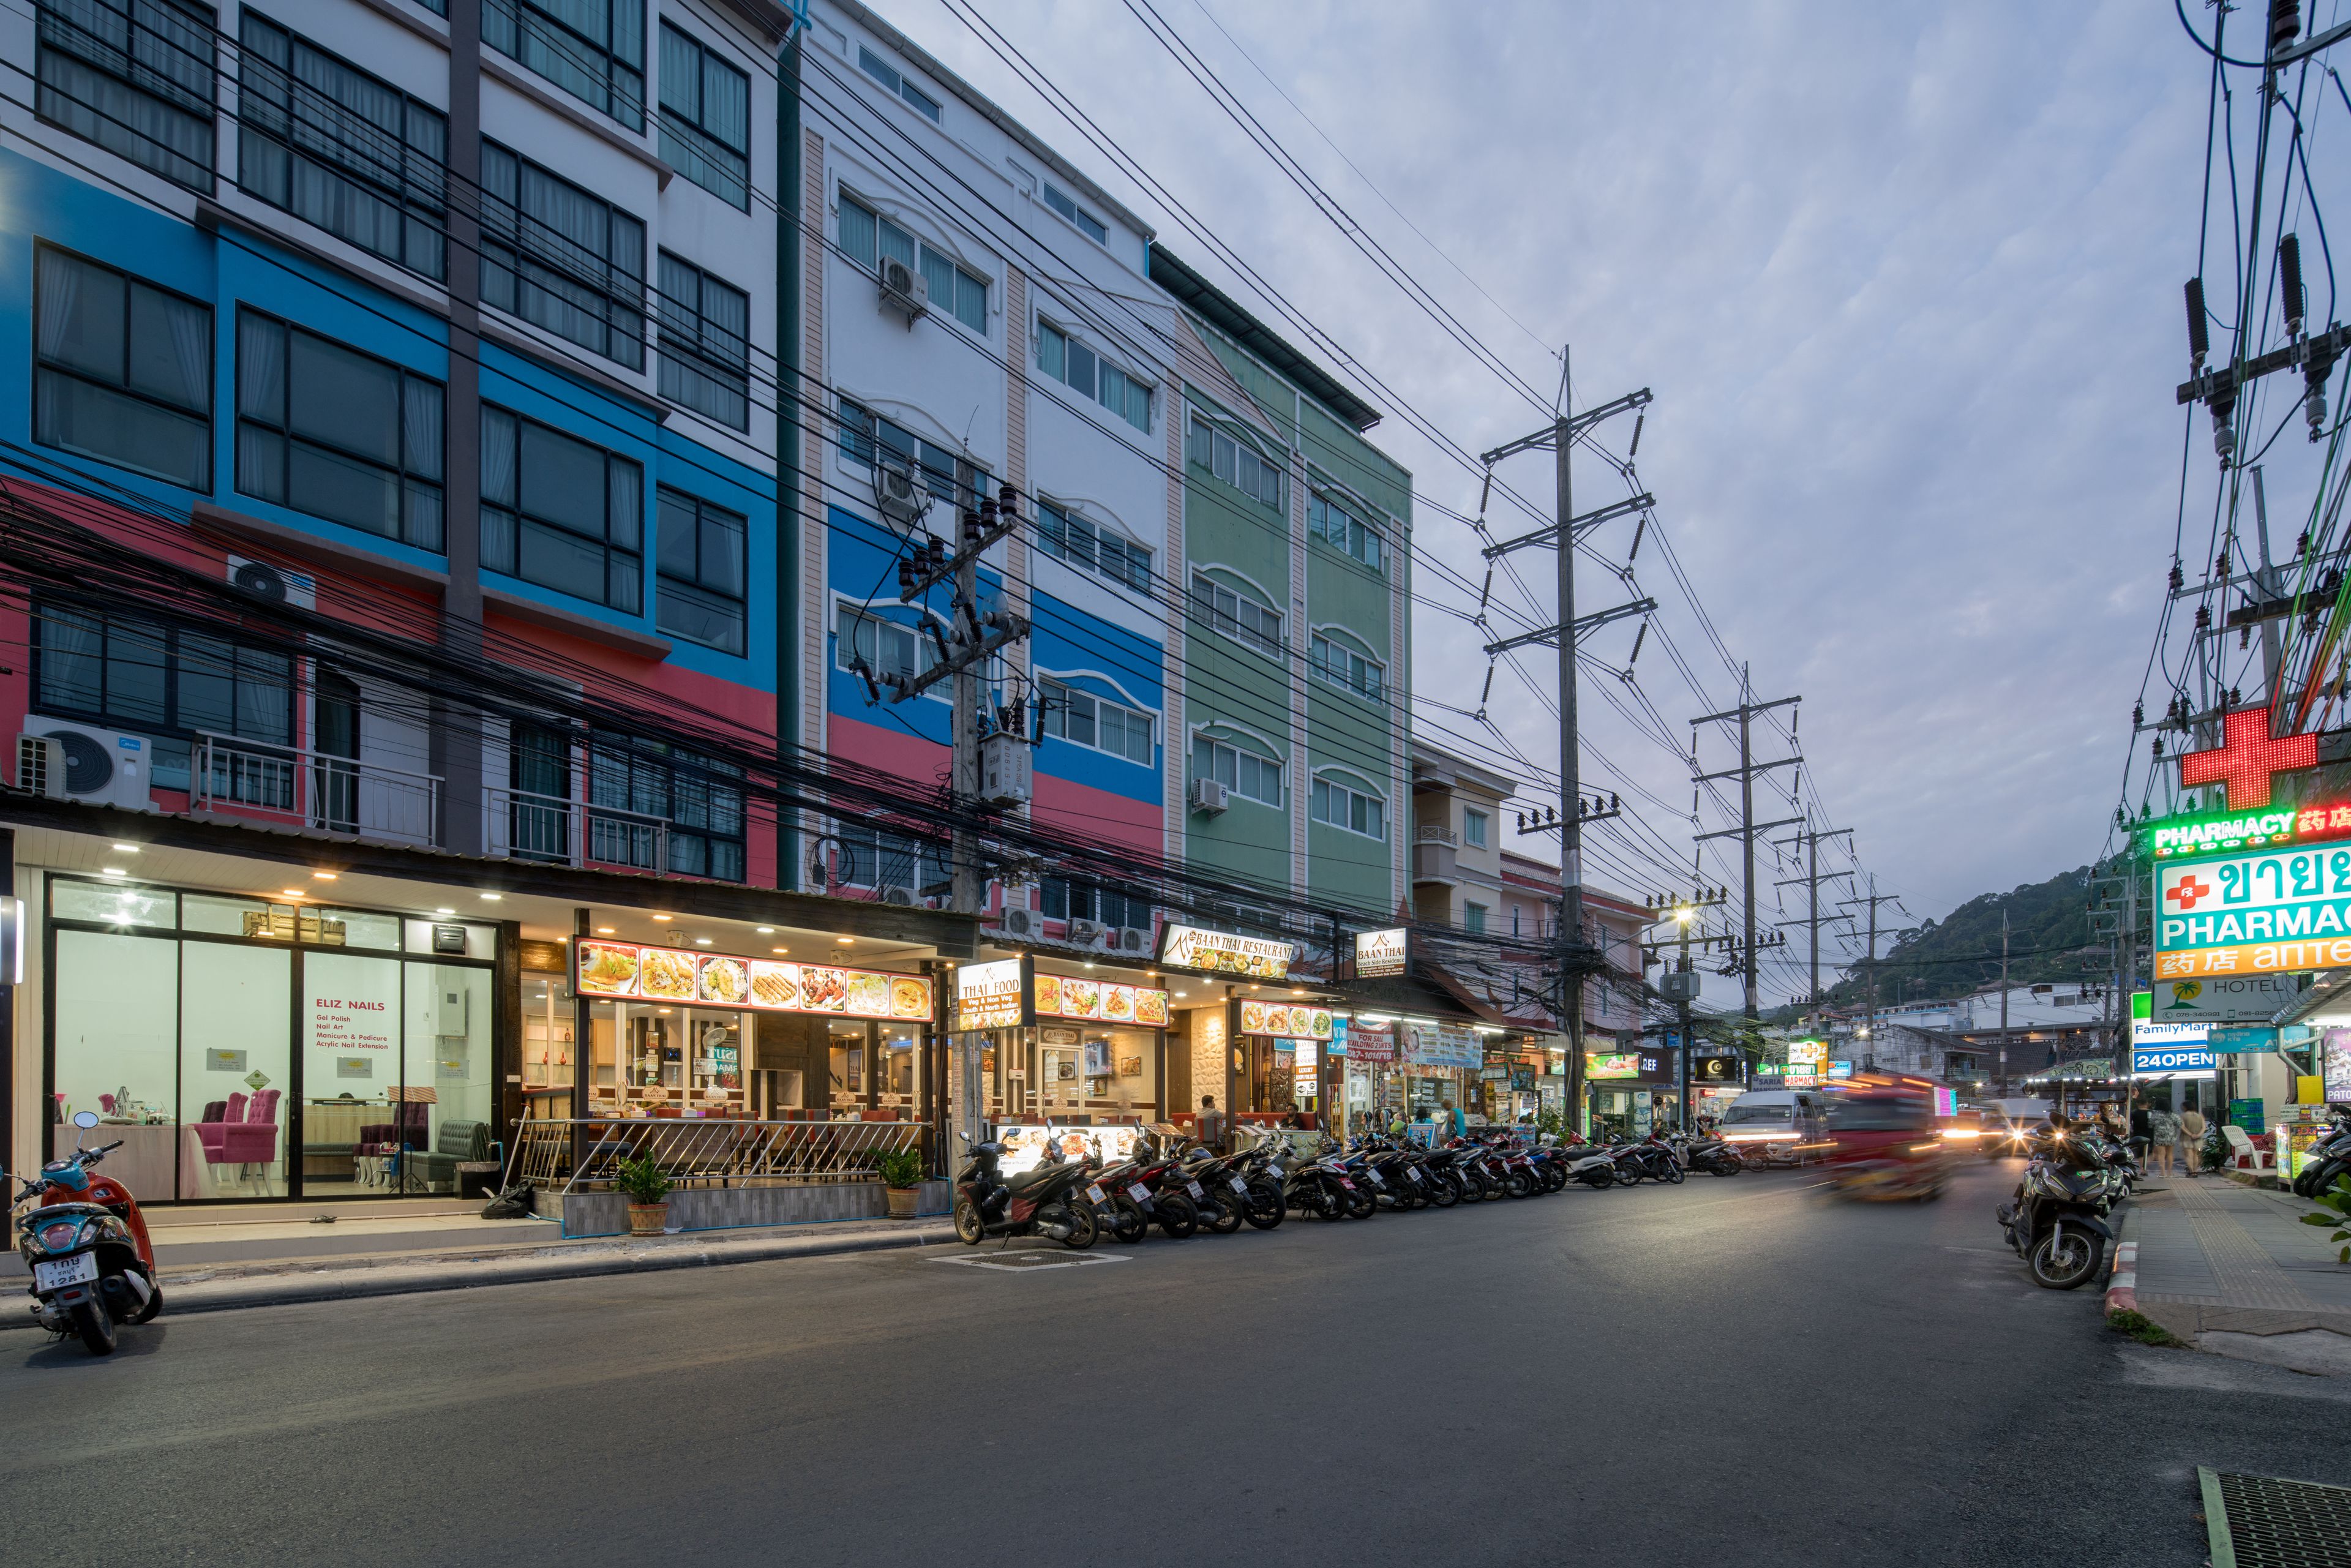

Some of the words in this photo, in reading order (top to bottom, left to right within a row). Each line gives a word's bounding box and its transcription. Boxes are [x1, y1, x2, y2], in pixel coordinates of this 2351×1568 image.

[2156, 812, 2296, 848] PHARMACY
[2162, 904, 2351, 946] PHARMA
[1196, 933, 1220, 947] BAAN
[1222, 937, 1241, 950] THAI
[1242, 940, 1292, 958] RESTAURANT
[1358, 949, 1382, 959] BAAN
[1384, 947, 1404, 957] THAI
[963, 984, 988, 998] THAI
[994, 979, 1019, 994] FOOD
[2214, 979, 2284, 993] HOTEL
[316, 999, 342, 1008] ELIZ
[348, 1000, 385, 1011] NAILS
[2135, 1022, 2214, 1035] FamilyMart
[1641, 1058, 1657, 1071] REE
[58, 1267, 75, 1276] ชลบุรี
[48, 1273, 86, 1286] 1281
